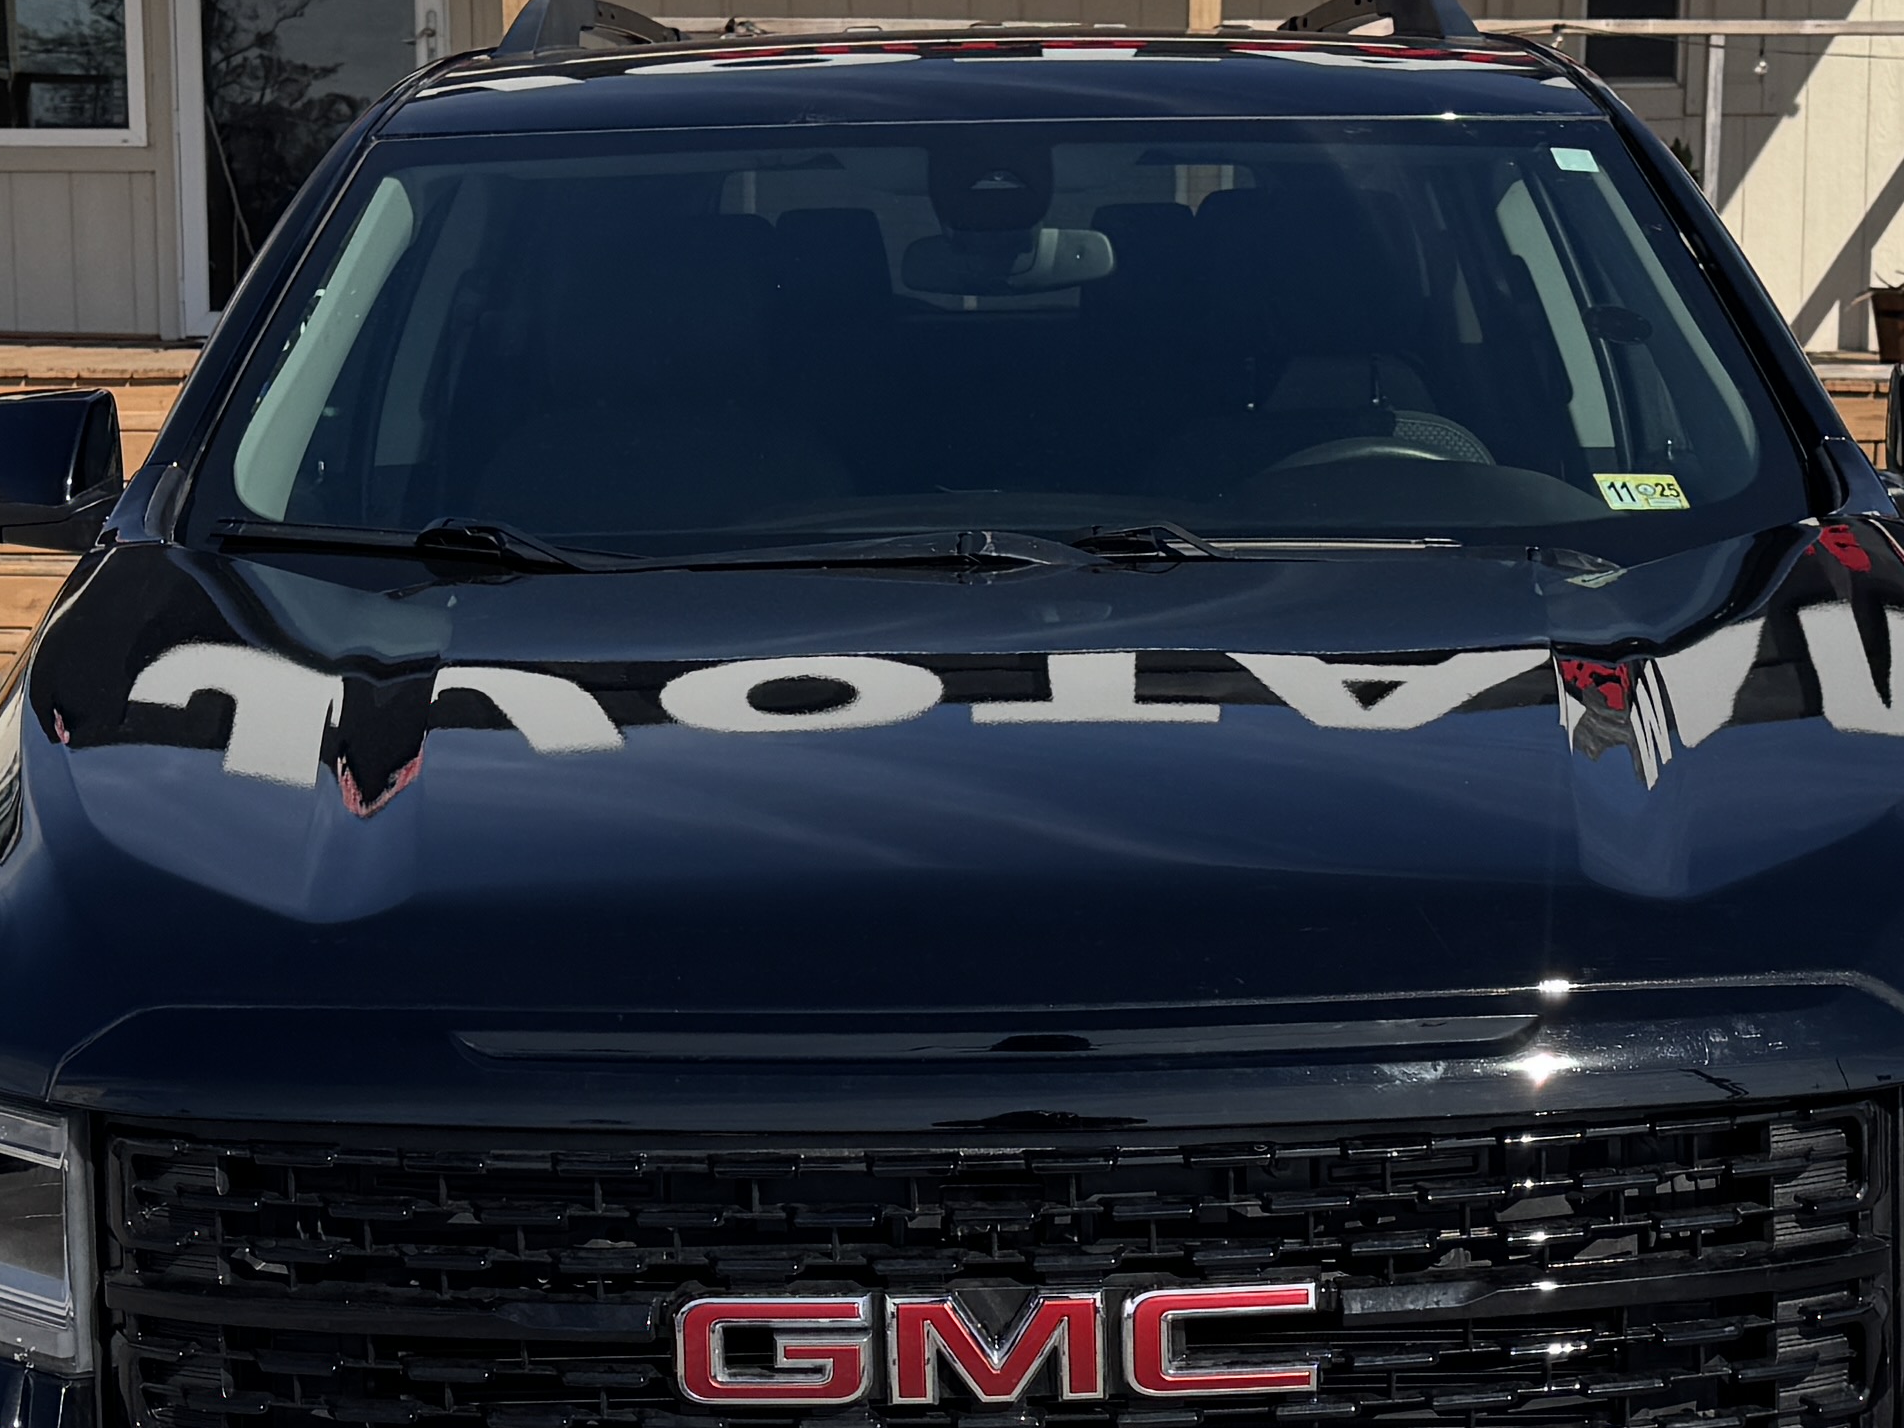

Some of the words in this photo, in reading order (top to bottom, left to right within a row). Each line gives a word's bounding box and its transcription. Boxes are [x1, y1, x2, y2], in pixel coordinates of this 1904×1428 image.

[1607, 481, 1637, 503] 11
[1654, 482, 1680, 498] 25
[675, 1280, 1319, 1404] GMC
